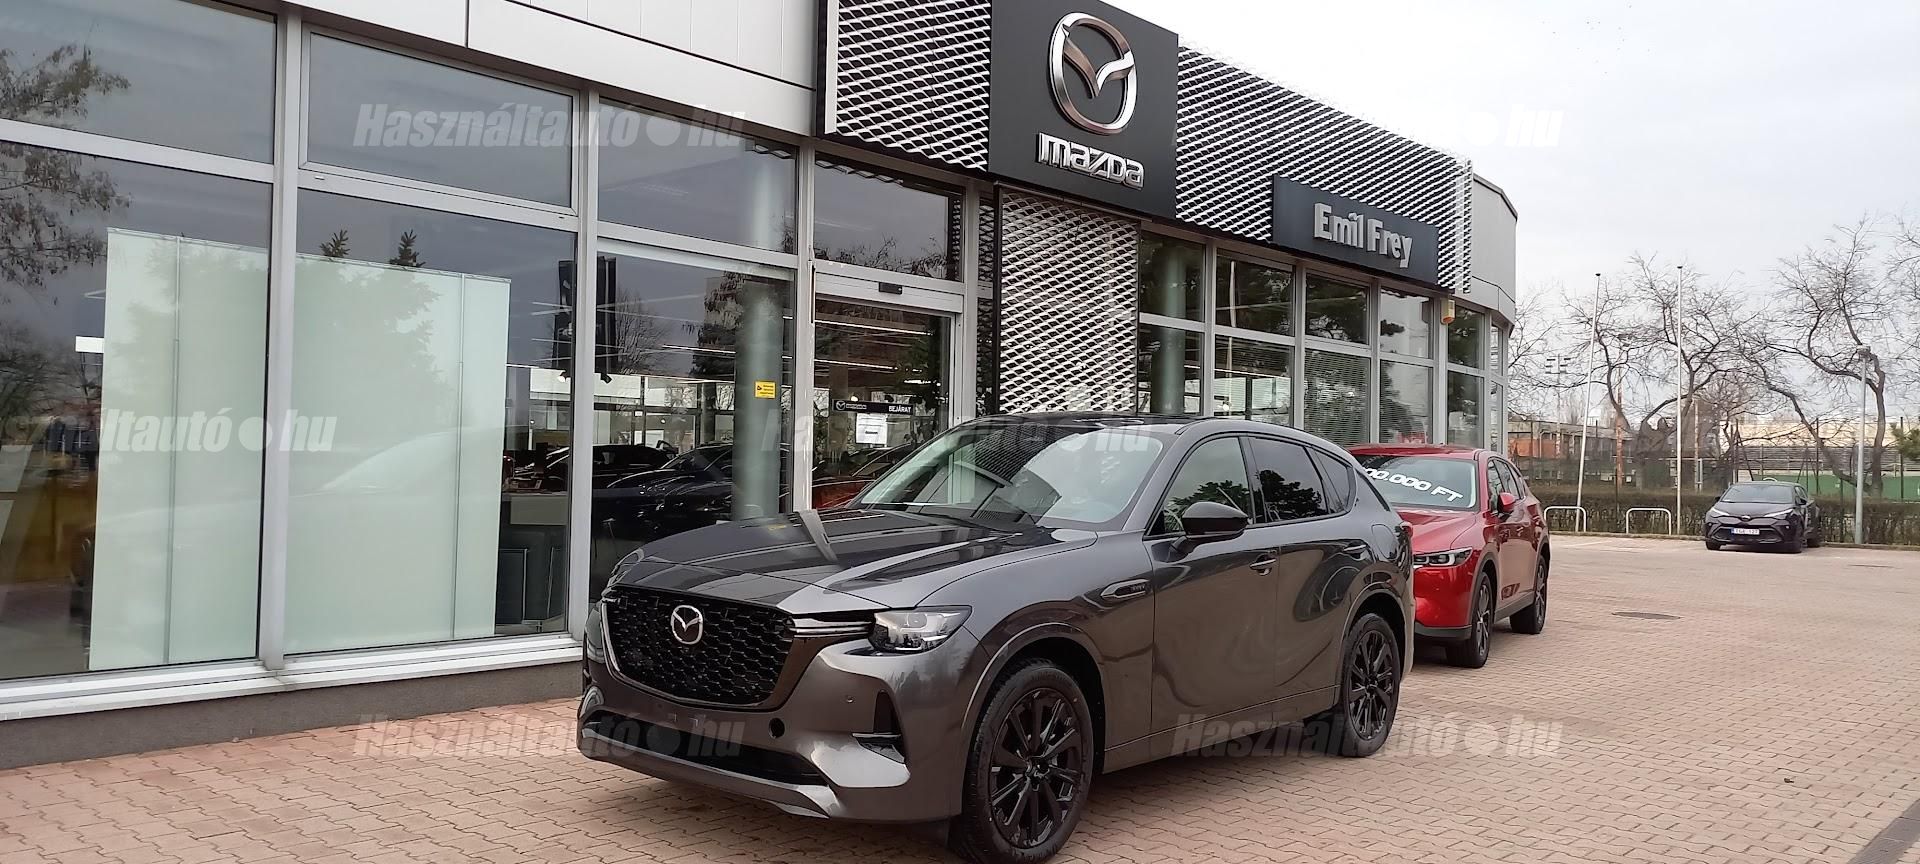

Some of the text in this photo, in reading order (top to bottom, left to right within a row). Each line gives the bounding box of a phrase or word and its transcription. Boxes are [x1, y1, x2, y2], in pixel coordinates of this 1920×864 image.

[1314, 202, 1413, 268] Emil Frey
[1431, 486, 1463, 502] FT
